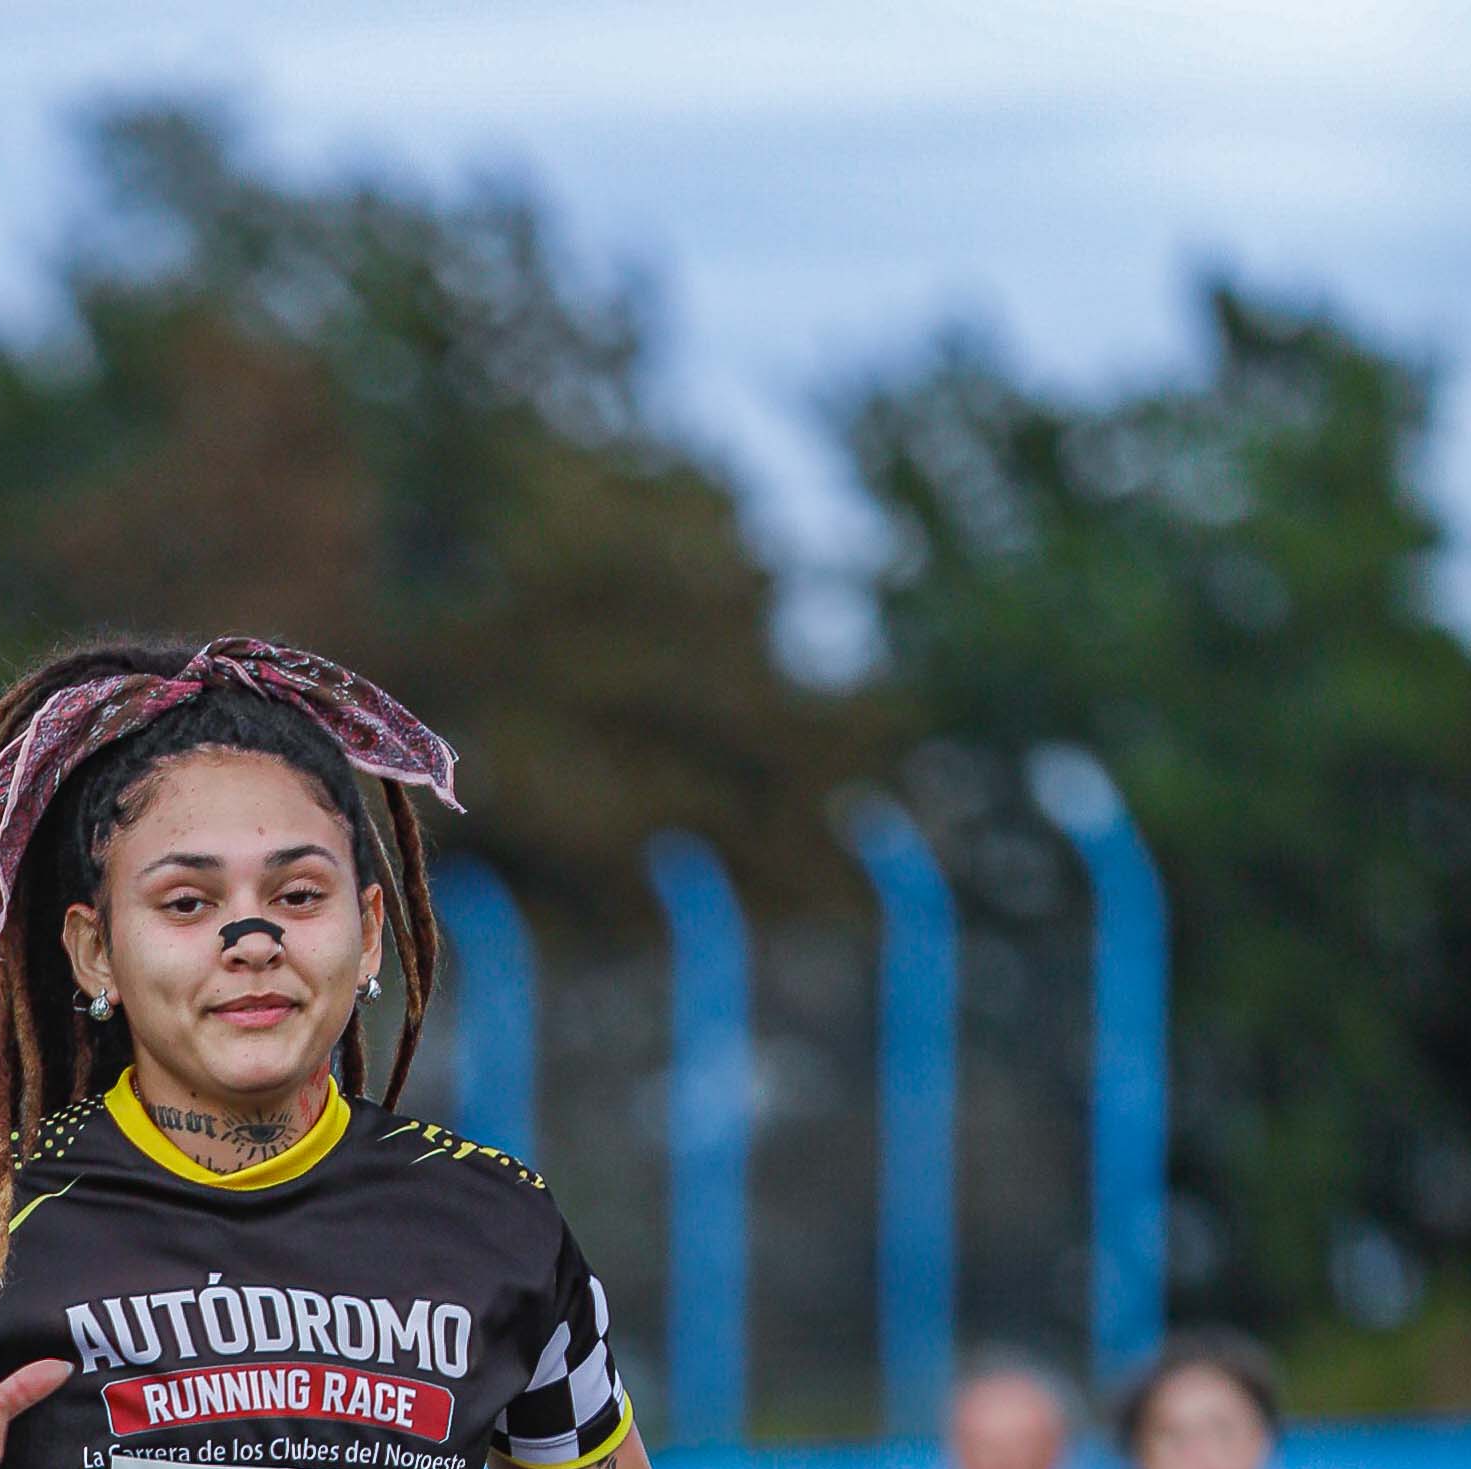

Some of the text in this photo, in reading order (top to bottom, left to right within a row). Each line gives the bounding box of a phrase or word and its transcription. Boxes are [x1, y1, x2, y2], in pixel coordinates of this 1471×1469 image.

[65, 1272, 472, 1379] AUTÓDROMO
[142, 1368, 417, 1429] RUNNING RACE
[83, 1446, 105, 1469] La
[198, 1439, 226, 1462] de
[233, 1438, 263, 1461] los
[270, 1437, 340, 1464] Clubes
[345, 1440, 380, 1465] del
